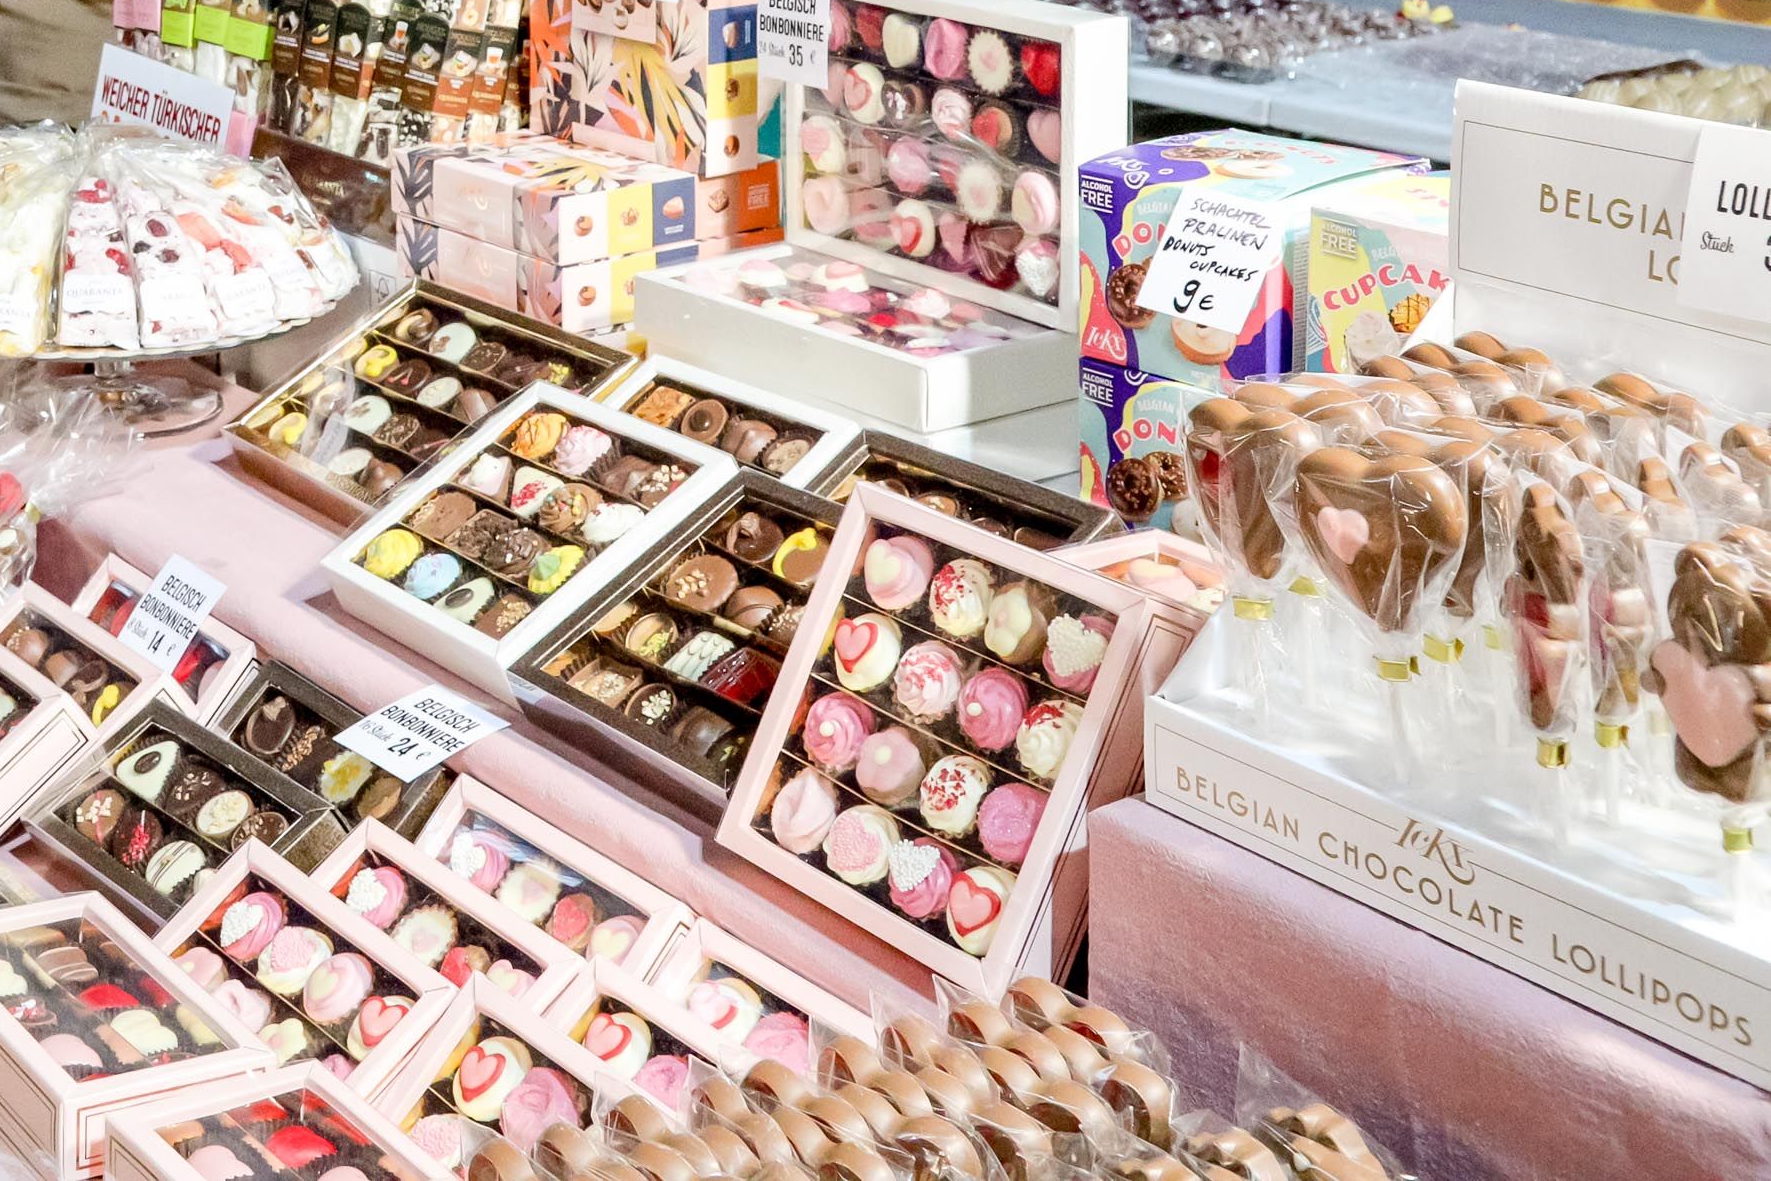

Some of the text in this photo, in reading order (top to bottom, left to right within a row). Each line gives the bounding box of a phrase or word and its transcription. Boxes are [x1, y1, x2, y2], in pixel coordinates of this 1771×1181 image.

[759, 14, 824, 42] BONBONNIERE
[789, 44, 804, 67] 35
[101, 75, 150, 120] WEICHER
[151, 89, 221, 144] TÜRKISCHER
[1081, 180, 1113, 194] ALCOHOL
[1081, 189, 1113, 209] FREE
[1190, 198, 1271, 229] SCHACHTEL
[1182, 218, 1268, 250] PRALINEN
[1323, 221, 1357, 238] ALCOHOL
[1162, 236, 1215, 256] DONUTS
[1321, 233, 1357, 253] FREE
[1081, 381, 1114, 403] FREE
[1082, 373, 1114, 388] ALCOHOL
[161, 575, 207, 613] BELGISCH
[140, 593, 197, 640] BONBONNIERE
[148, 630, 166, 654] 14
[414, 698, 480, 733] BELGISCH
[380, 705, 465, 753] BONBONNIERE
[387, 737, 419, 757] 24
[1177, 766, 1753, 1047] BELGIAN CHOCOLATE LOLLIPOPS
